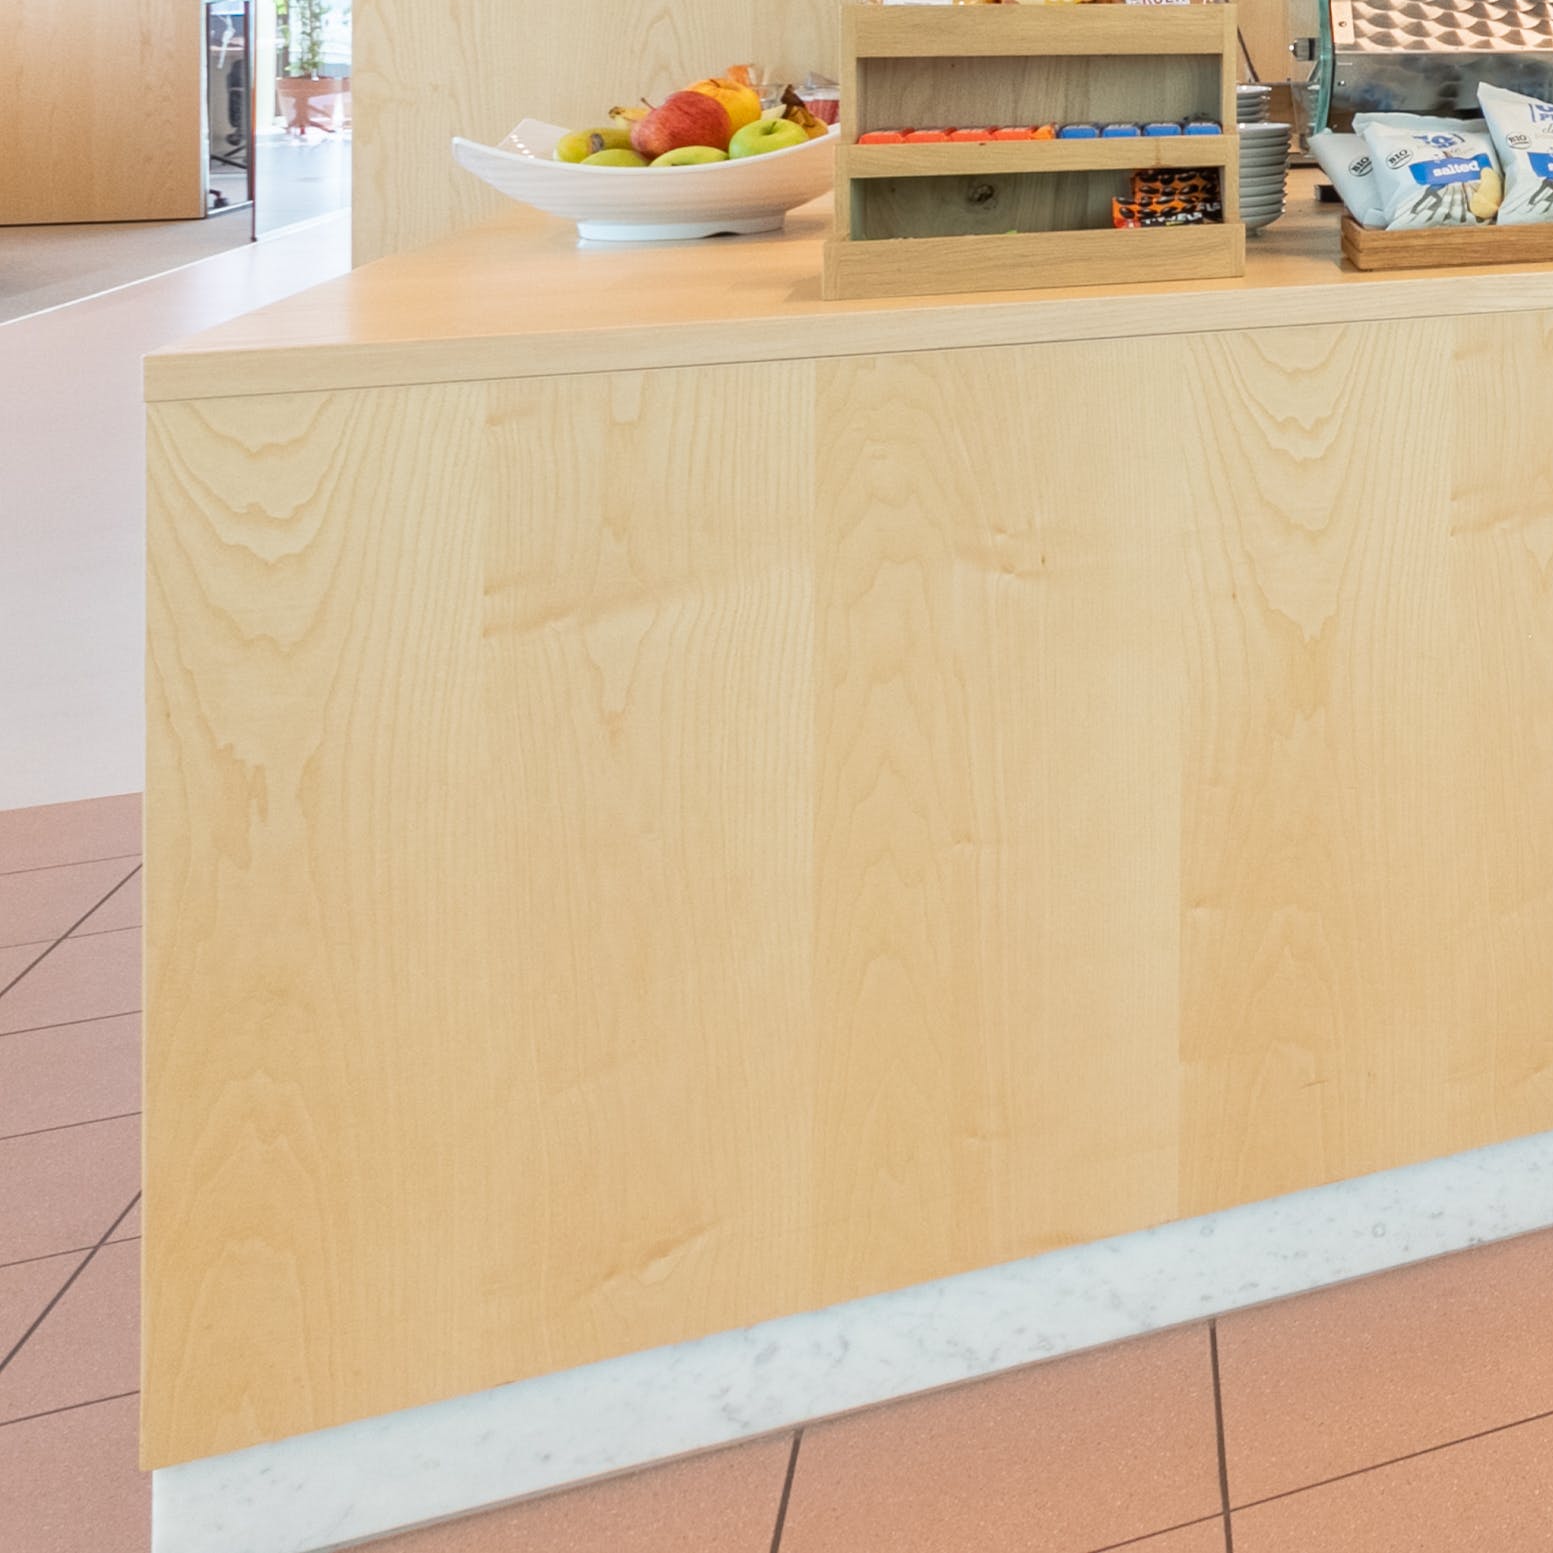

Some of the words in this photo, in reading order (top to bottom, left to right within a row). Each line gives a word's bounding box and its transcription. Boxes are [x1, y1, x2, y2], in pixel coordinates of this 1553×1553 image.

[1351, 155, 1370, 173] BIO
[1387, 149, 1409, 165] BIO
[1432, 160, 1481, 177] salted
